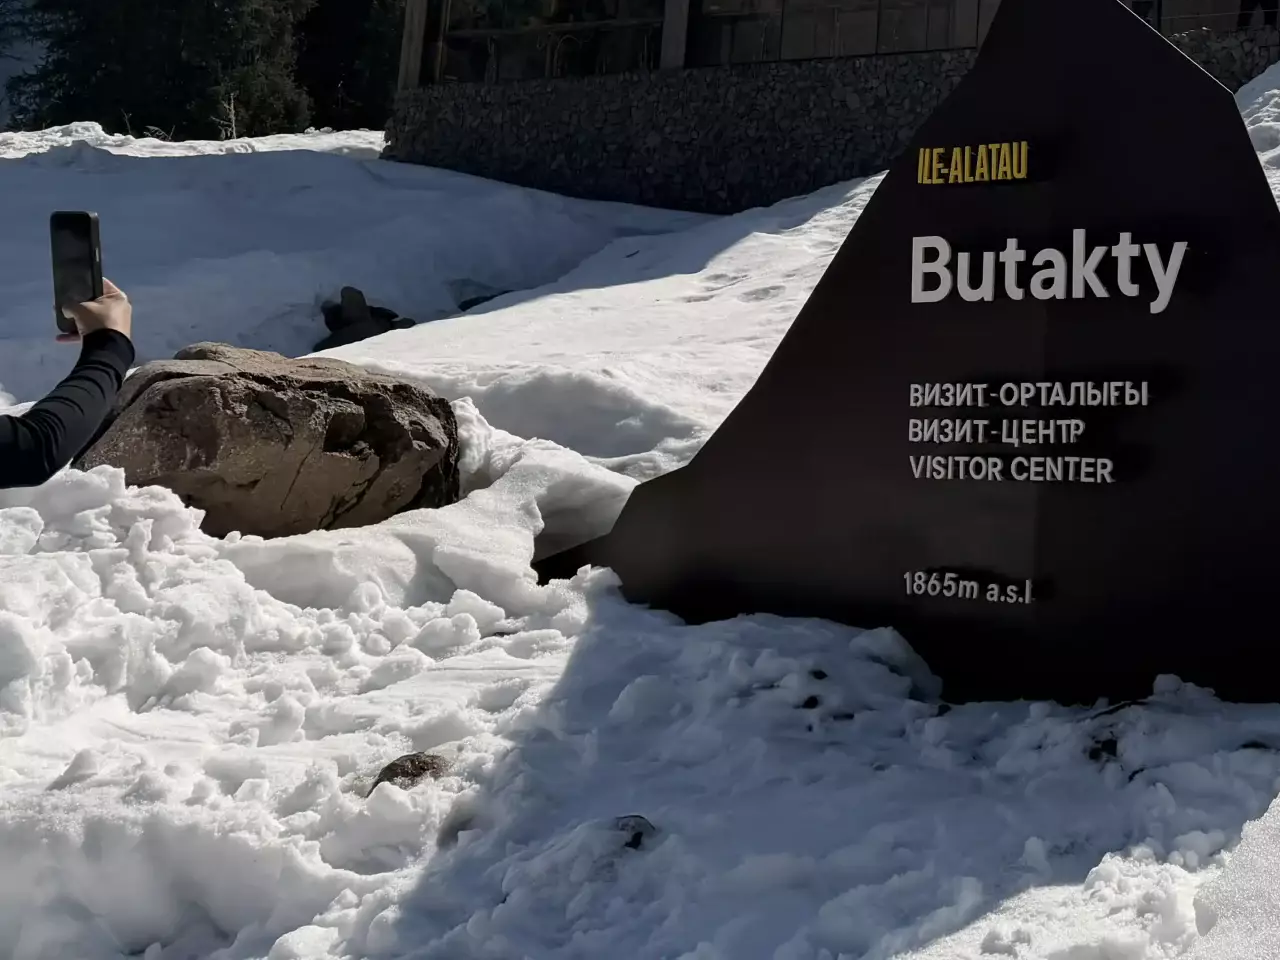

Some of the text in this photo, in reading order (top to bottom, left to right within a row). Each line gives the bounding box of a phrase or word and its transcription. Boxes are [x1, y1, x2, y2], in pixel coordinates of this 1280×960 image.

[917, 141, 1028, 184] ILE-ALATAU
[911, 228, 1188, 314] Butakty
[908, 418, 1085, 447] ВИЗИТ-ЦЕНТР
[909, 455, 1115, 483] VISITOR CENTER
[903, 571, 979, 599] 1865m
